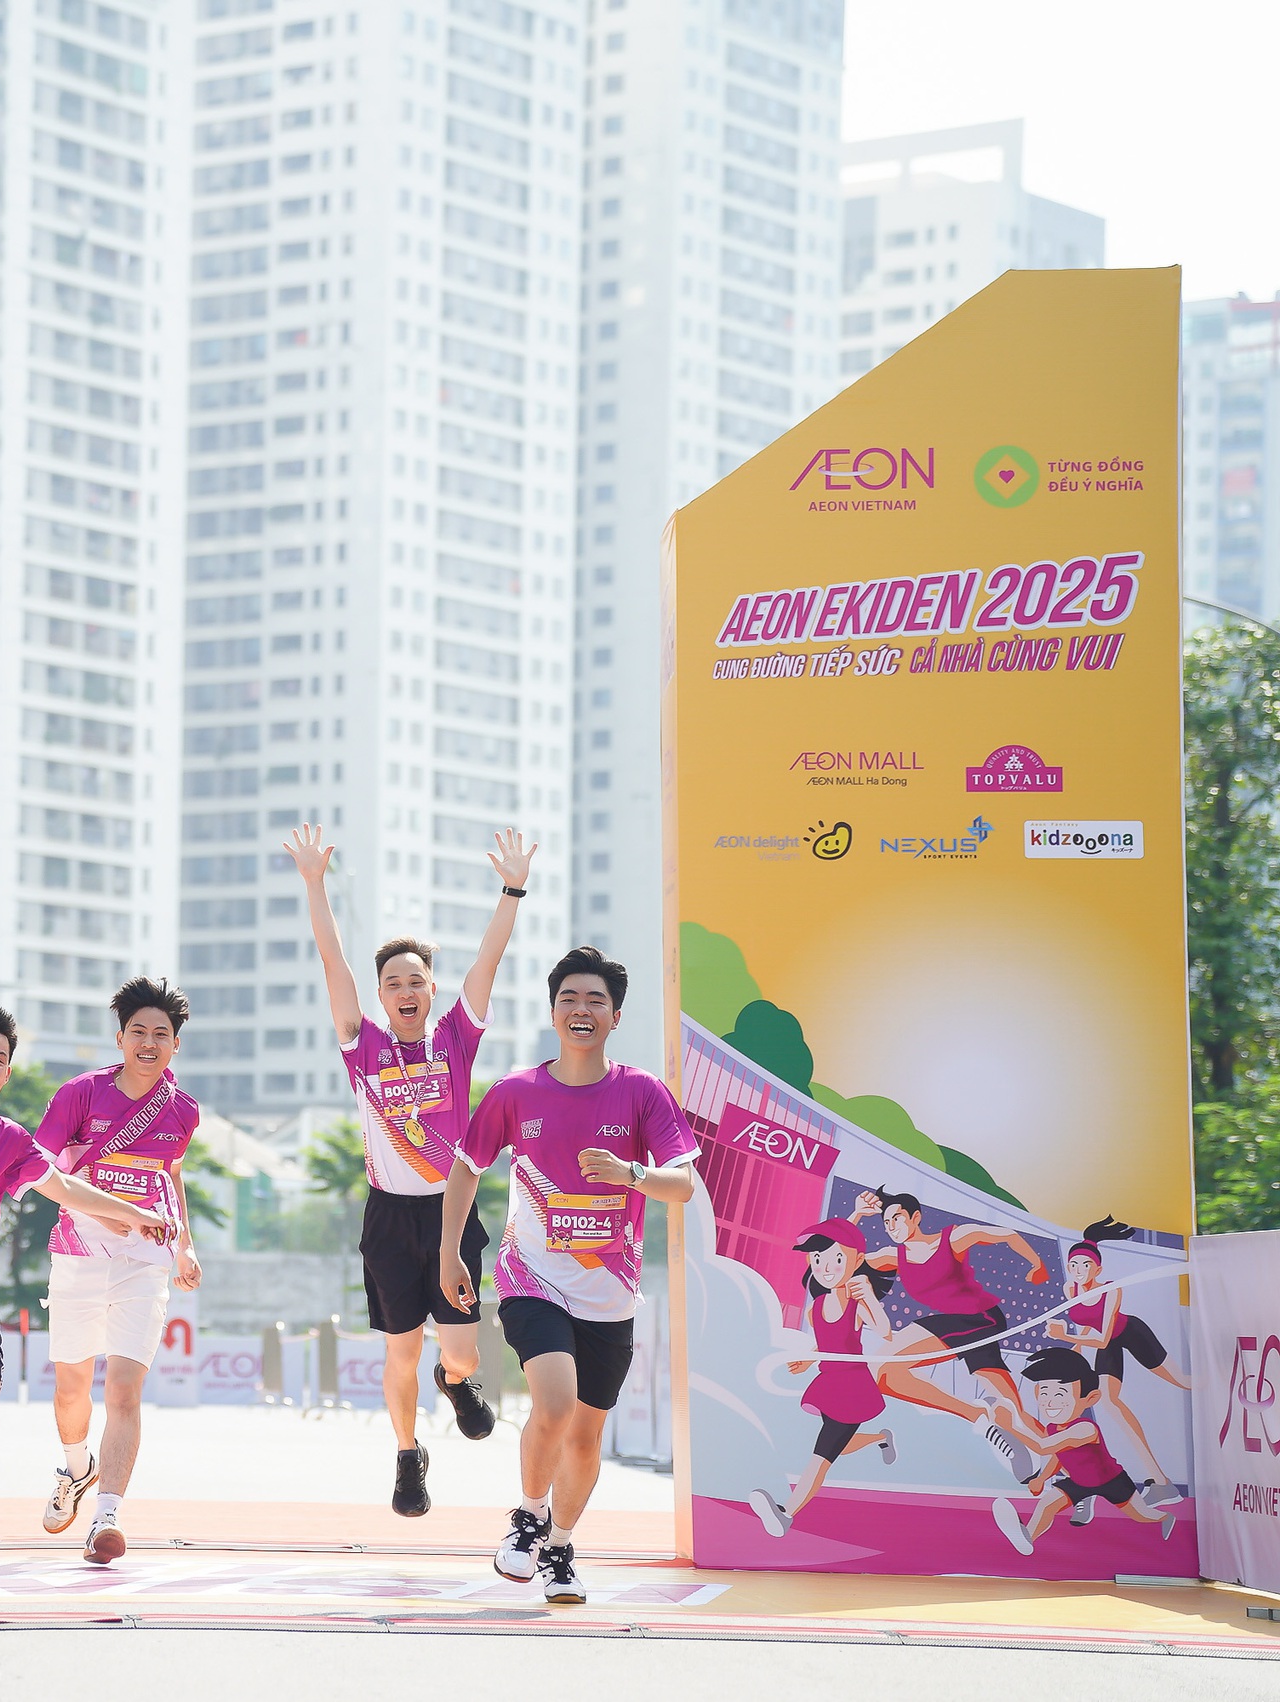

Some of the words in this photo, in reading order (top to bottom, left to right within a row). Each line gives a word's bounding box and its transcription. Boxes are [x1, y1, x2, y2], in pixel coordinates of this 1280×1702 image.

[1048, 458, 1092, 473] TỪNG
[1097, 456, 1144, 472] ĐỒNG
[1048, 476, 1078, 492] ĐỀU
[1082, 478, 1092, 492] Ý
[1095, 477, 1144, 491] NGHĨA
[808, 501, 848, 512] AEON
[851, 500, 916, 511] VIETNAM
[717, 588, 820, 644] AEON
[812, 571, 978, 637] EKIDEN
[975, 553, 1140, 628] 2025
[712, 659, 750, 680] CUNG
[750, 652, 807, 679] ĐƯỜNG
[809, 643, 855, 677] TIẾP
[854, 643, 904, 676] SỨC
[909, 637, 938, 673] CẢ
[937, 637, 984, 673] NHÀ
[987, 634, 1063, 672] CÙNG
[1065, 633, 1125, 671] VUI
[859, 752, 925, 770] MALL
[836, 777, 864, 785] MALL
[866, 777, 879, 785] Ha
[882, 777, 907, 787] Dong
[972, 774, 1057, 785] TOPVALU
[753, 836, 799, 850] delight
[1030, 829, 1134, 850] kidzooona
[880, 838, 977, 859] NEXUS
[1232, 1482, 1262, 1515] AEON
